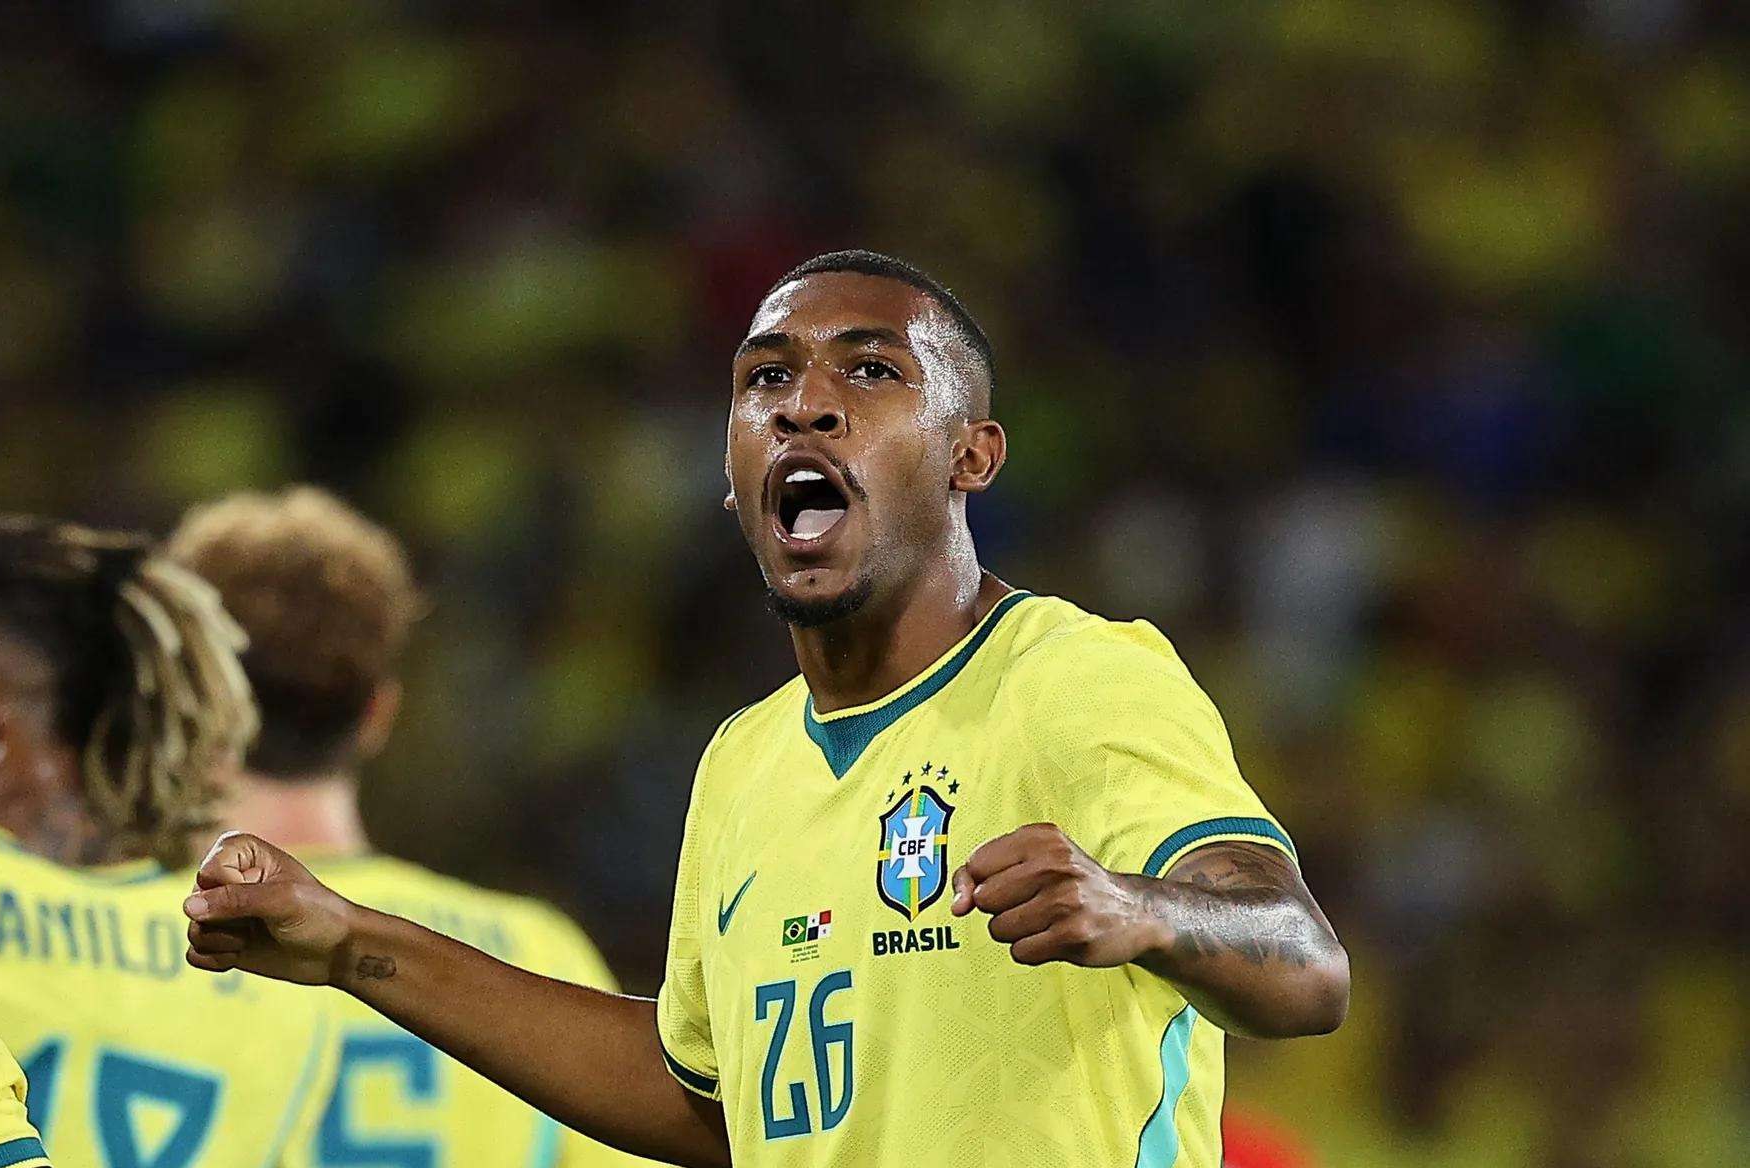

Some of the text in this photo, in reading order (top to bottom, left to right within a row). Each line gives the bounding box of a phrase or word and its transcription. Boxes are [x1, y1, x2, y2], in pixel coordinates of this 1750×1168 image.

[898, 838, 927, 856] CBF
[872, 925, 960, 956] BRASIL
[754, 969, 855, 1141] 26
